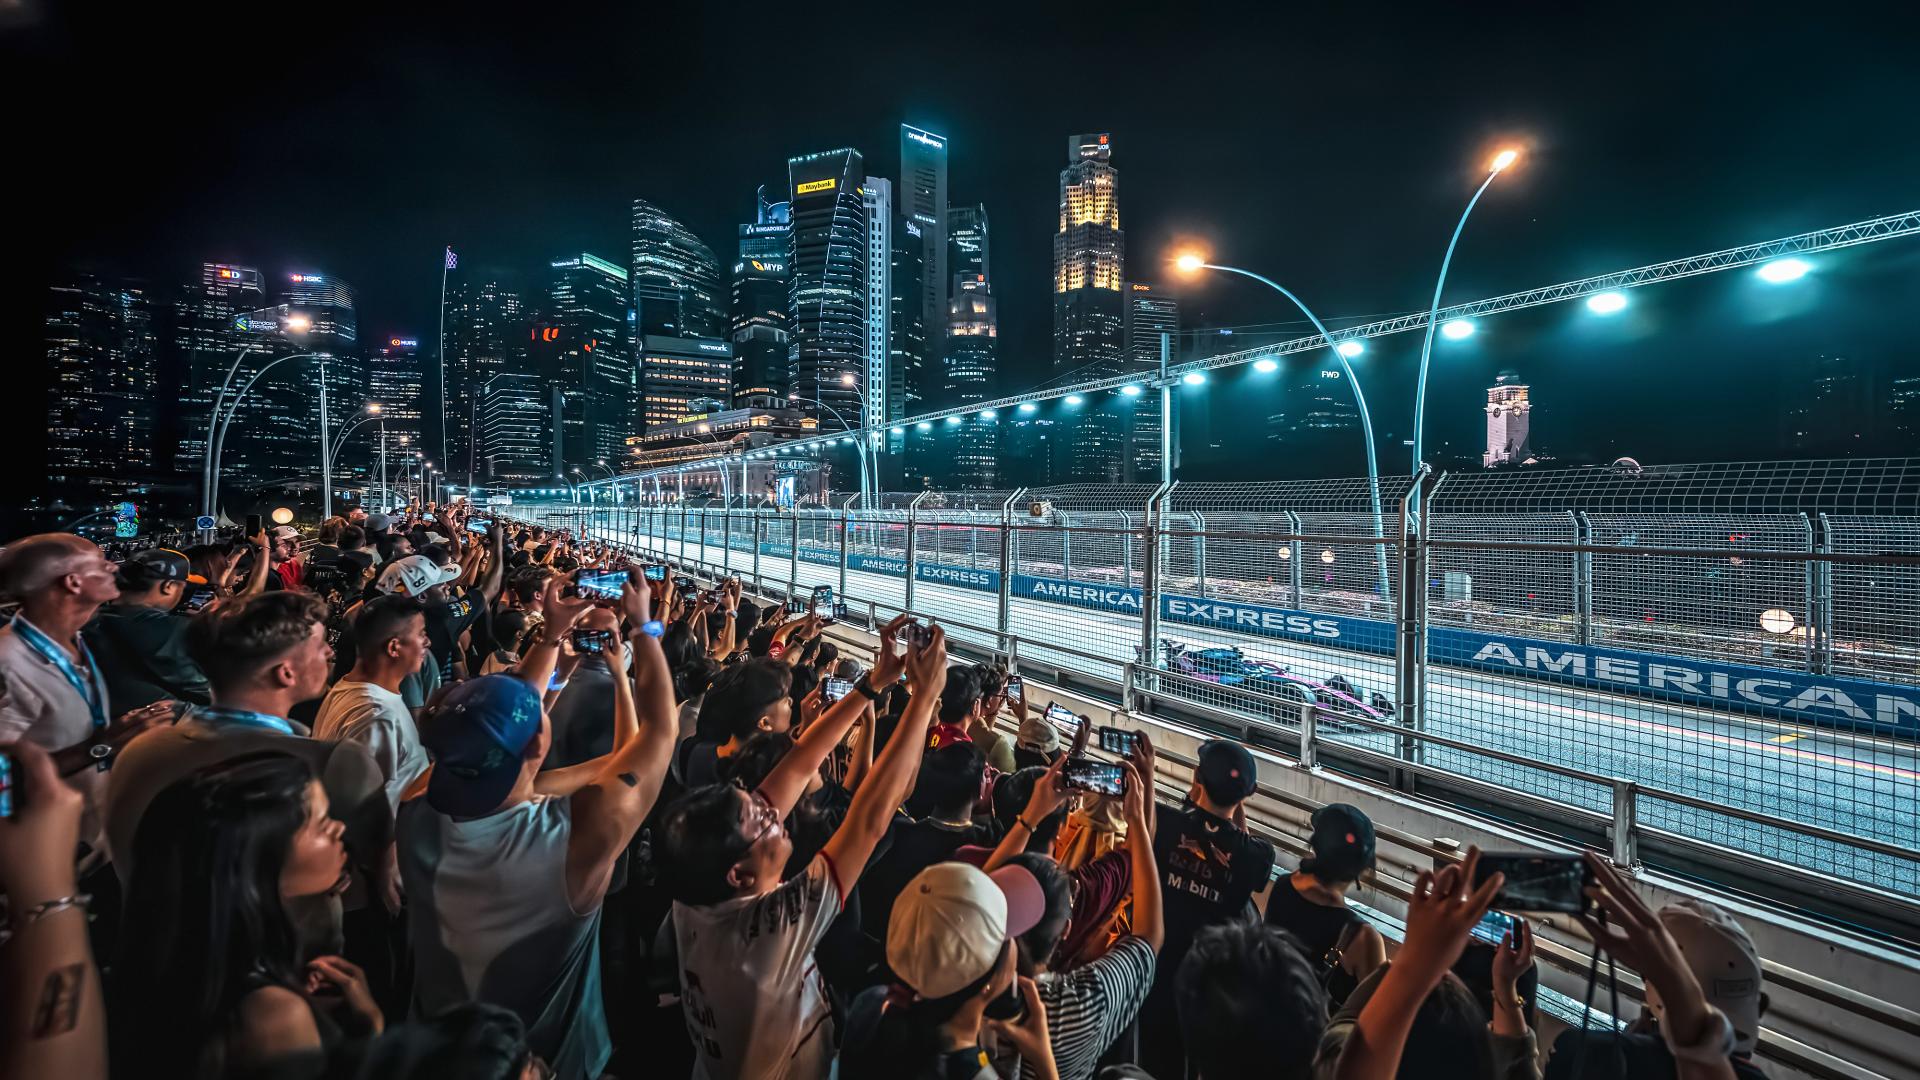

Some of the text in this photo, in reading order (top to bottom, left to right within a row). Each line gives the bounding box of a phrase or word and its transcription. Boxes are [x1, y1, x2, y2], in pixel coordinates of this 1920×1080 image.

[805, 181, 832, 190] Maybank
[764, 262, 783, 271] MYP
[700, 344, 728, 352] wework
[862, 559, 989, 585] AMERICA EXPRESS
[1033, 581, 1340, 638] AMERICA EXPRESS
